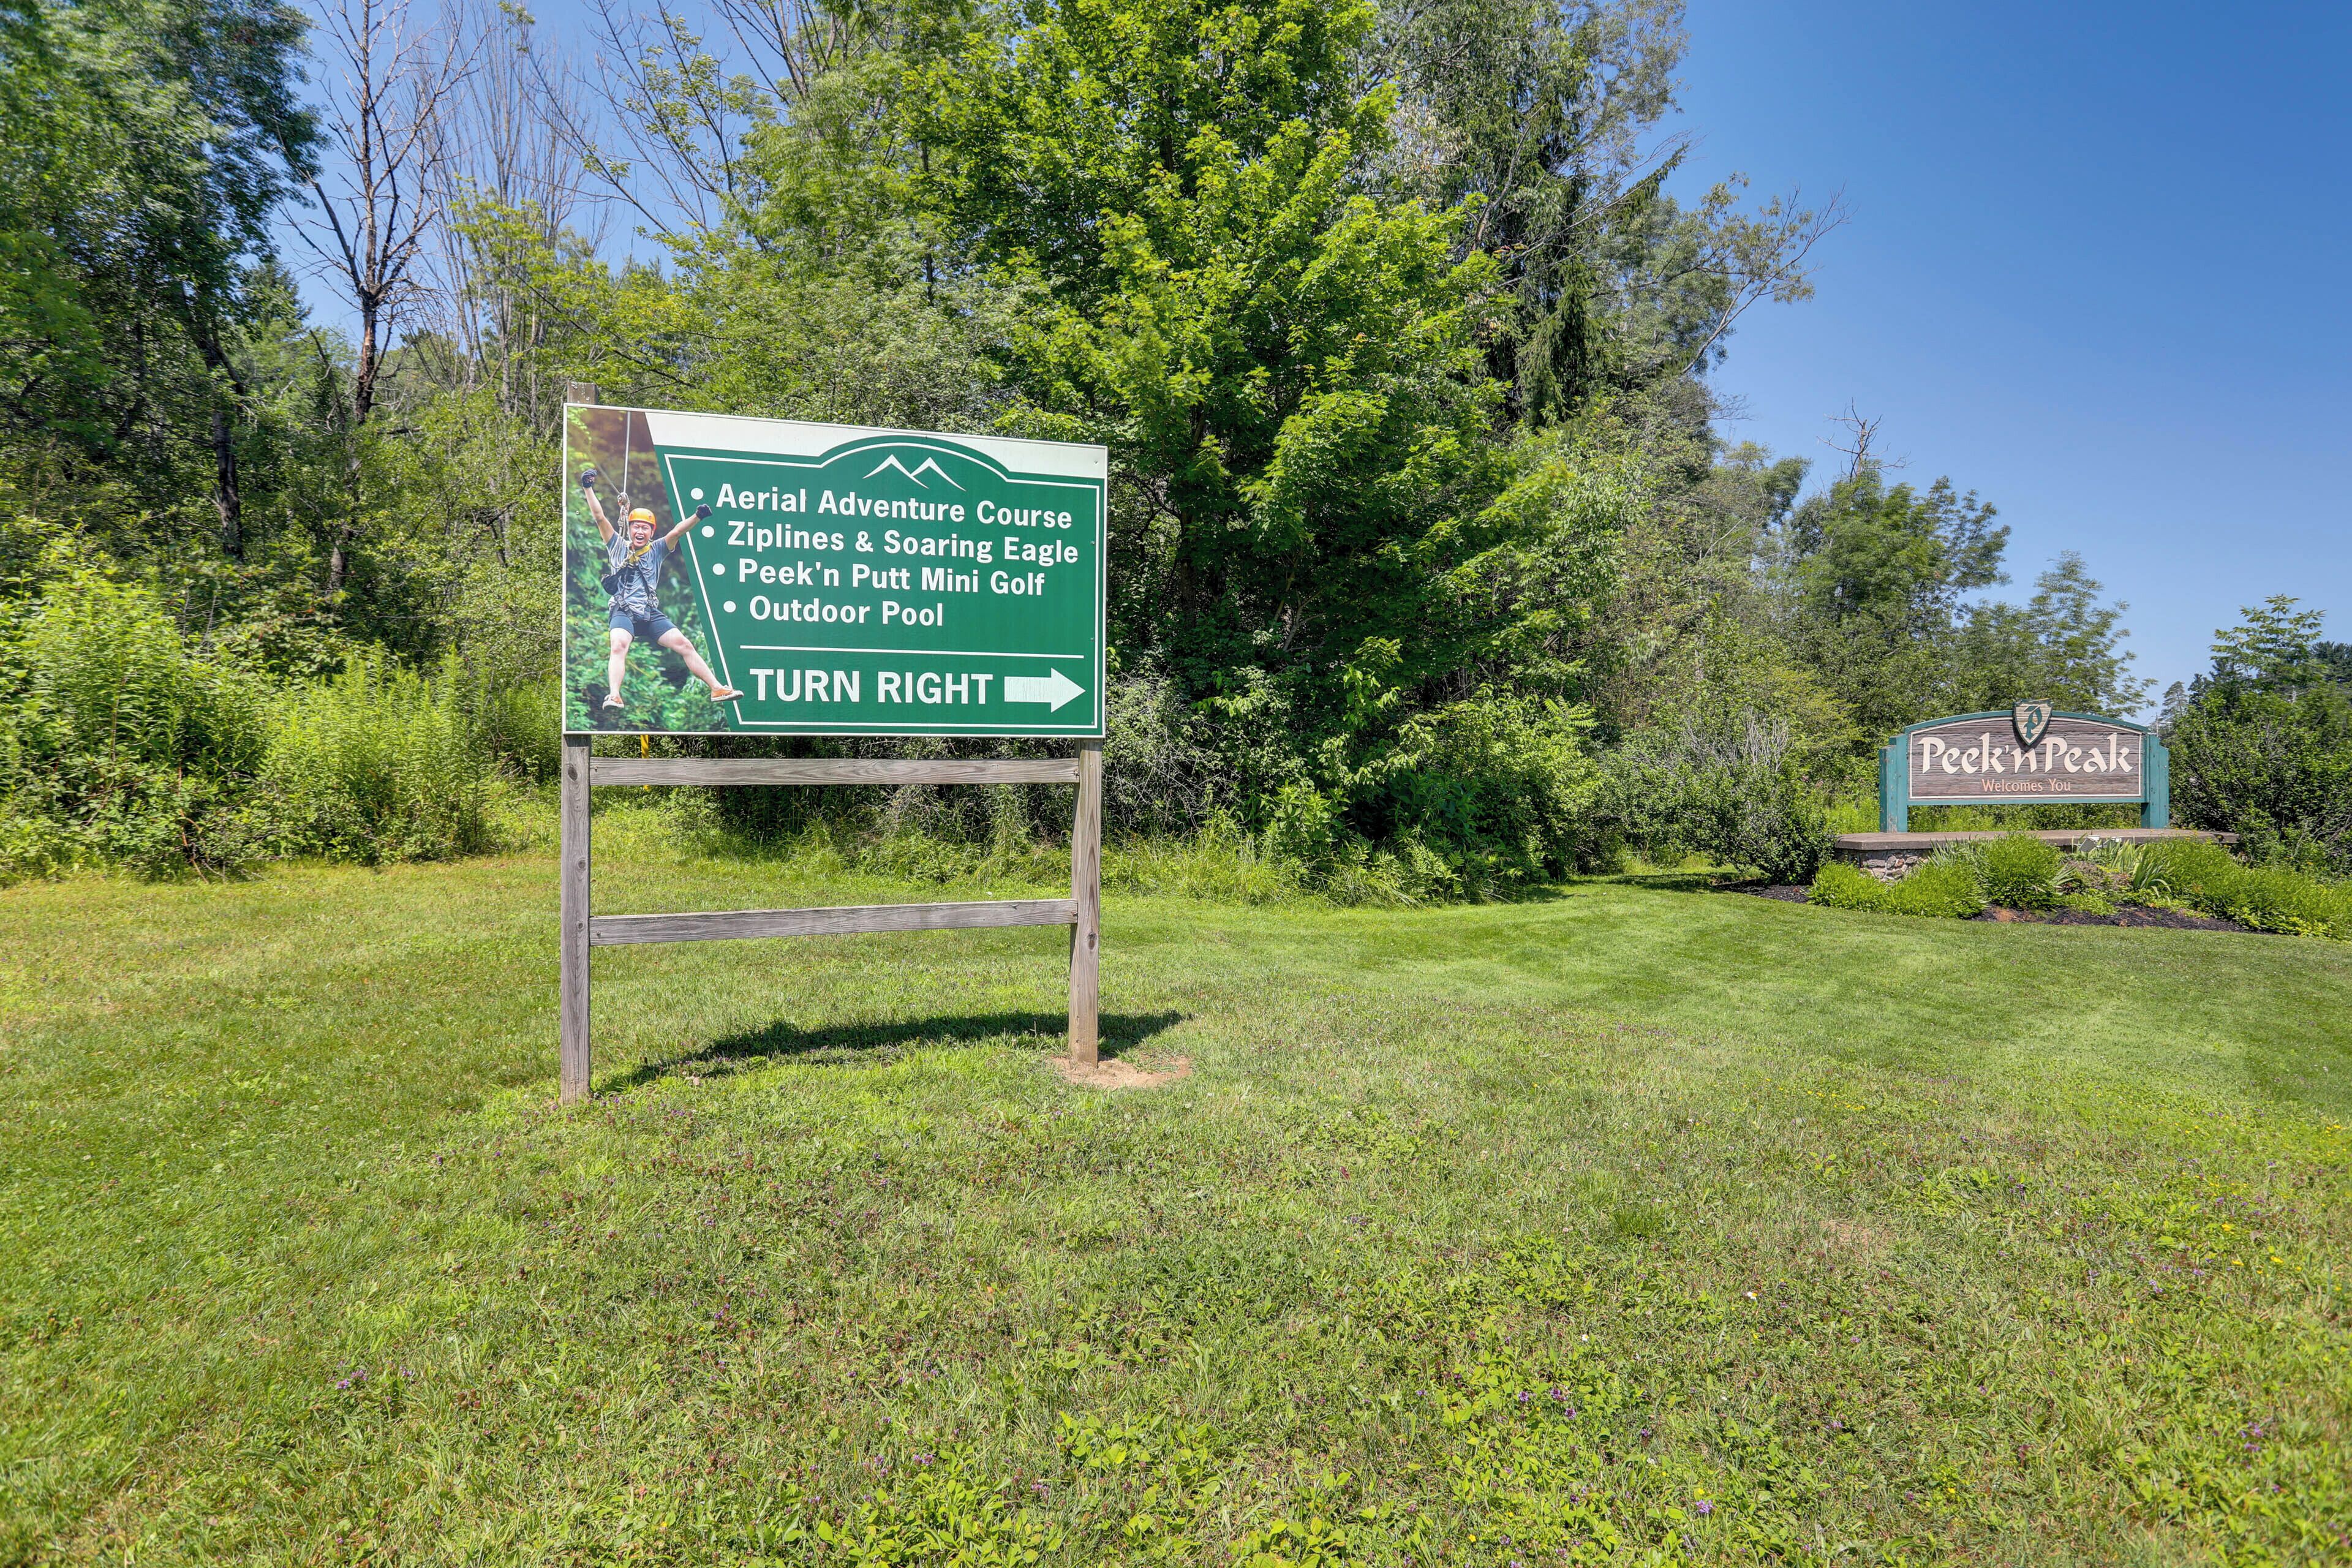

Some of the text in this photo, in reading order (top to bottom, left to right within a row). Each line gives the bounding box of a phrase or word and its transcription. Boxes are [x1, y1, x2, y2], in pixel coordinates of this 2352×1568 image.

[715, 483, 1072, 529] Aerial Adventure Course
[728, 520, 1078, 567] Ziplines & Soaring Eagle
[739, 558, 1045, 596] Peek'n Putt Mini Golf
[749, 595, 943, 627] Outdoor Pool
[749, 668, 993, 704] TURN RIGHT
[2041, 733, 2133, 773] Peak
[1981, 778, 2071, 792] Welcomes You
